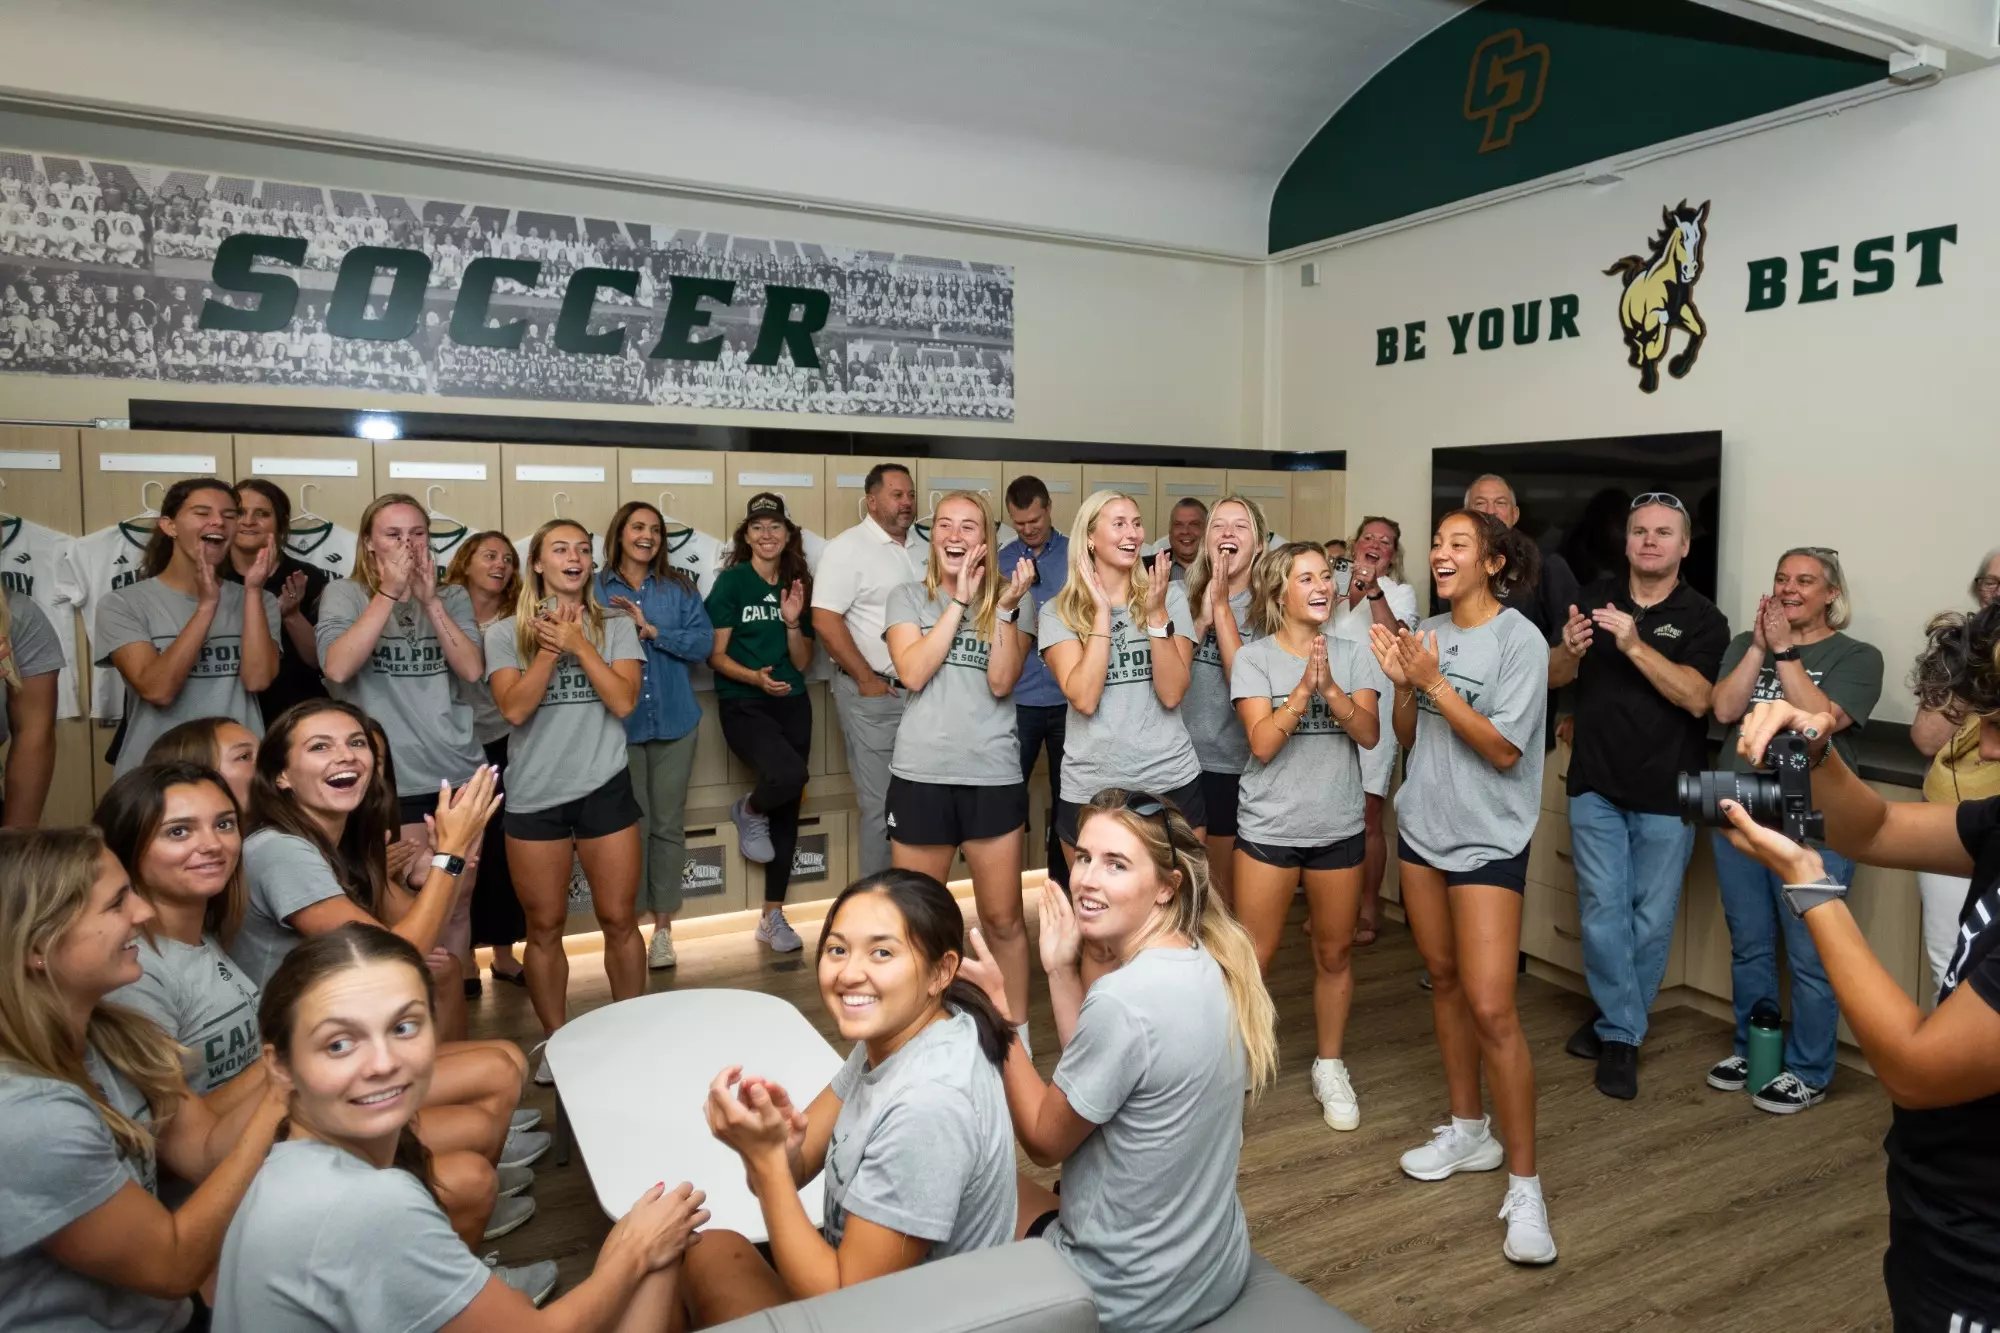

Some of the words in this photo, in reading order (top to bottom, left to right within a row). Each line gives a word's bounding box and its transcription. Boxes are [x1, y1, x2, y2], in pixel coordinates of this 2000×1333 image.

[199, 232, 831, 370] SOCCER
[1375, 320, 1426, 366] BE
[1447, 293, 1581, 355] YOUR
[1744, 223, 1958, 313] BEST
[1, 570, 34, 597] OLY
[742, 605, 768, 623] CAL
[200, 645, 241, 662] POL
[411, 646, 444, 661] POL
[951, 636, 992, 656] POL
[960, 653, 989, 667] SOCCE
[205, 1019, 256, 1063] CAL
